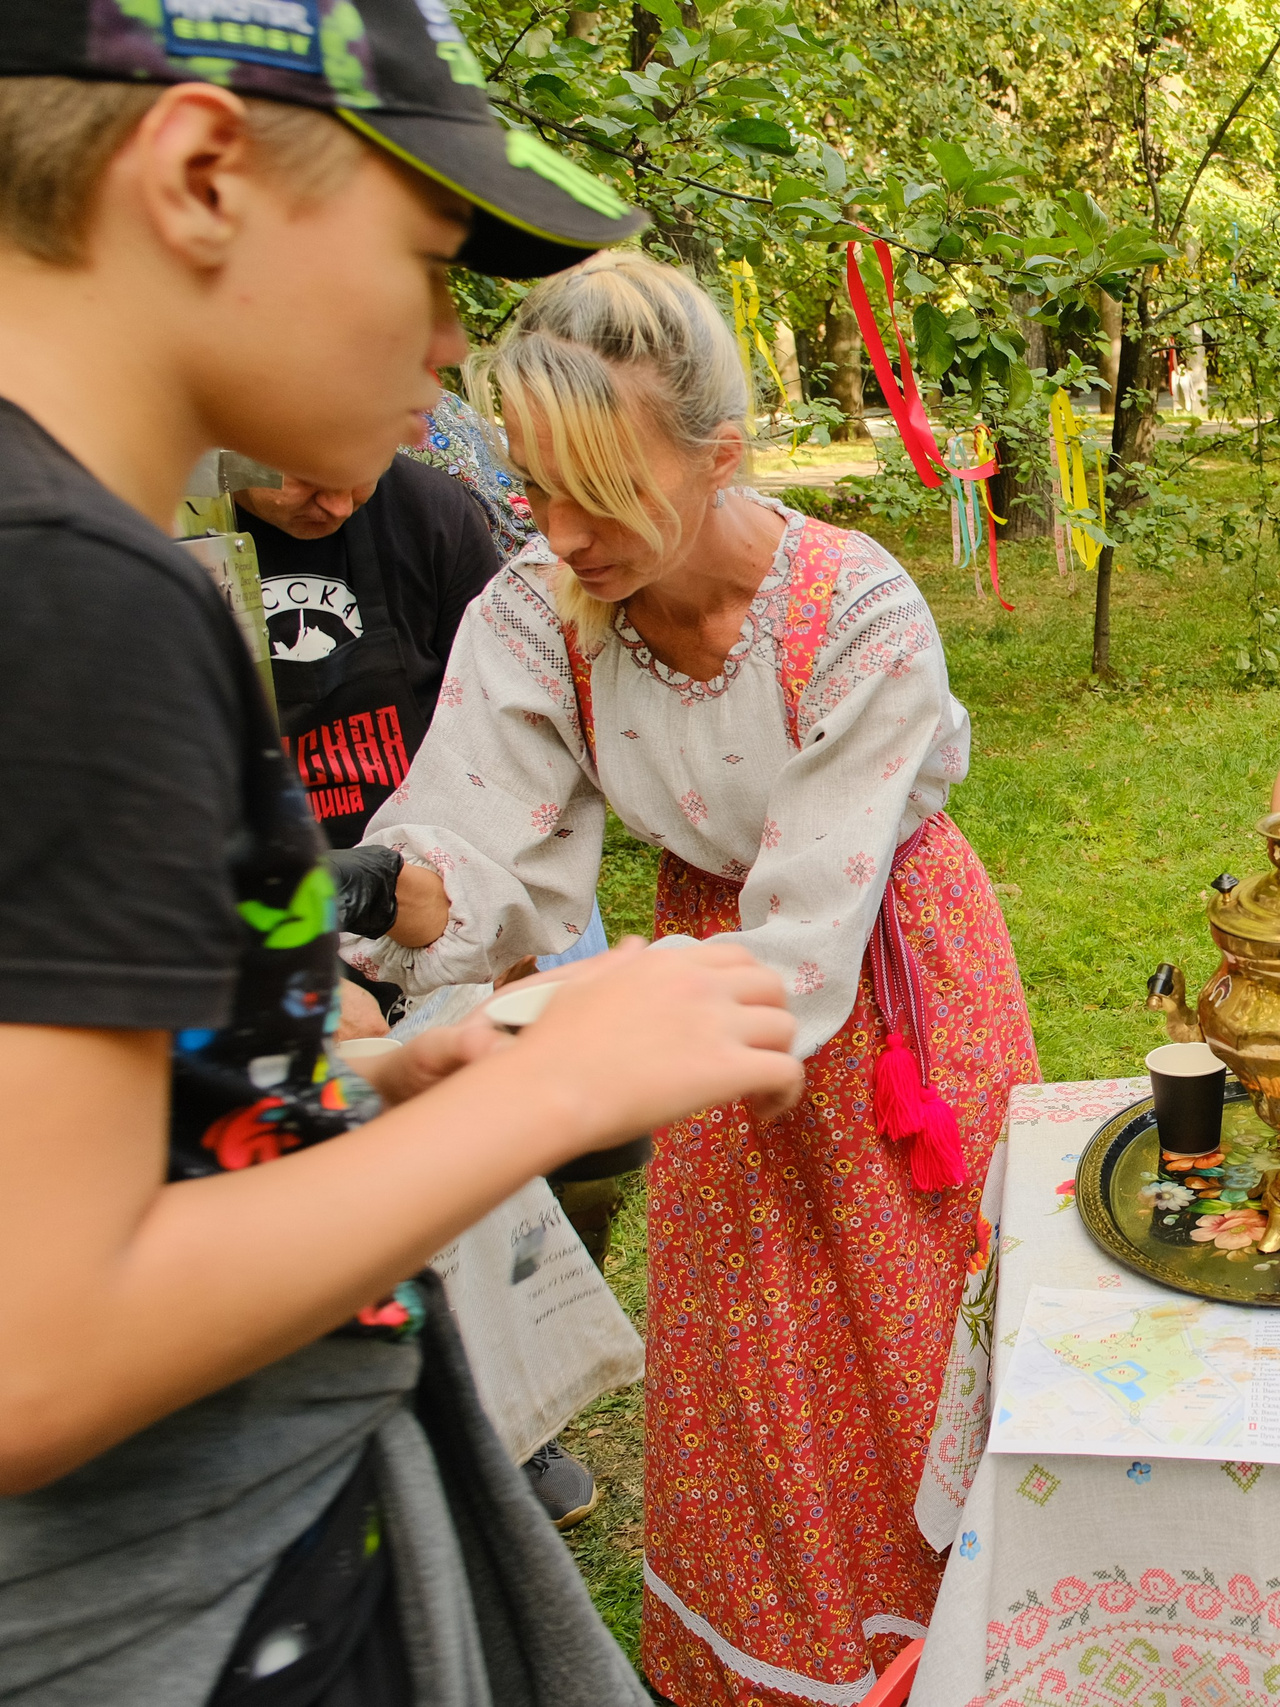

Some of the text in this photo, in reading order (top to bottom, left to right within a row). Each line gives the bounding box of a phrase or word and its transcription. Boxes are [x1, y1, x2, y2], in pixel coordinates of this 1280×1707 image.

[172, 17, 311, 55] ENERGY
[263, 581, 363, 635] ССКА
[281, 705, 410, 789] СКАЯ
